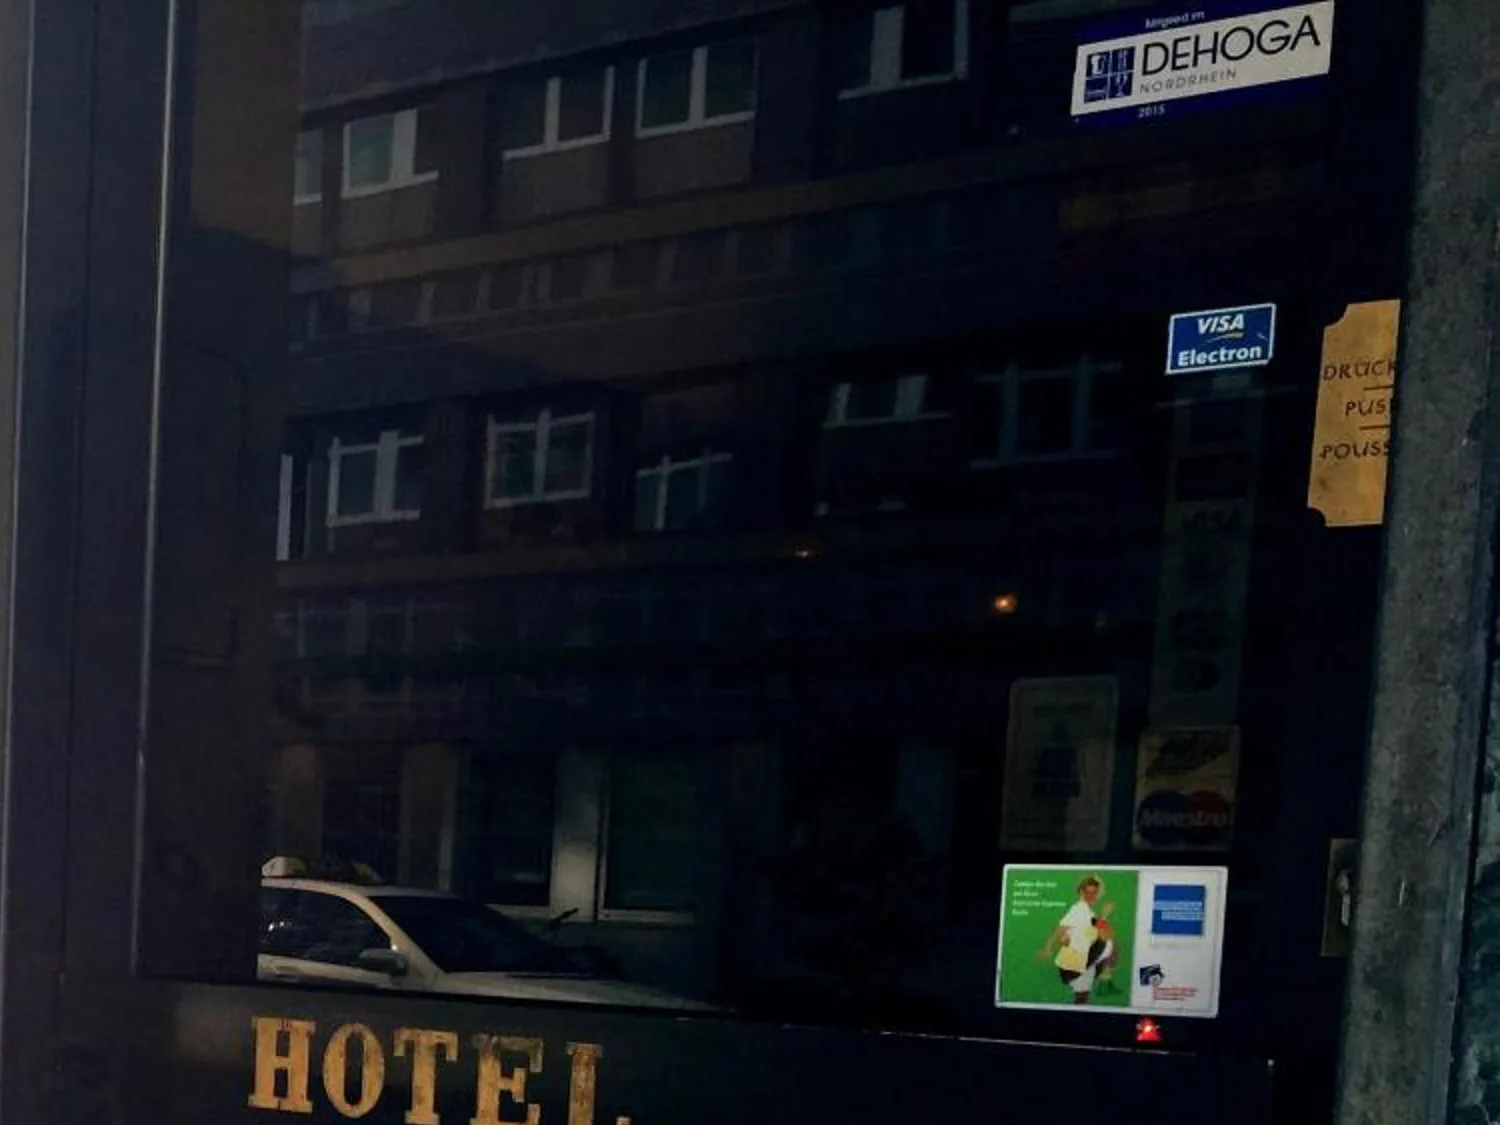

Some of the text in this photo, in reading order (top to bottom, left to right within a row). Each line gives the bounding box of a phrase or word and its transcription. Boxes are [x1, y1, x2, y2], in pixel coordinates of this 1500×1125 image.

[1142, 15, 1321, 76] DEHOGA
[1139, 69, 1237, 93] NORDRHEIN
[1197, 314, 1245, 334] VISA
[1177, 346, 1261, 367] Electron
[1345, 400, 1388, 417] PUS
